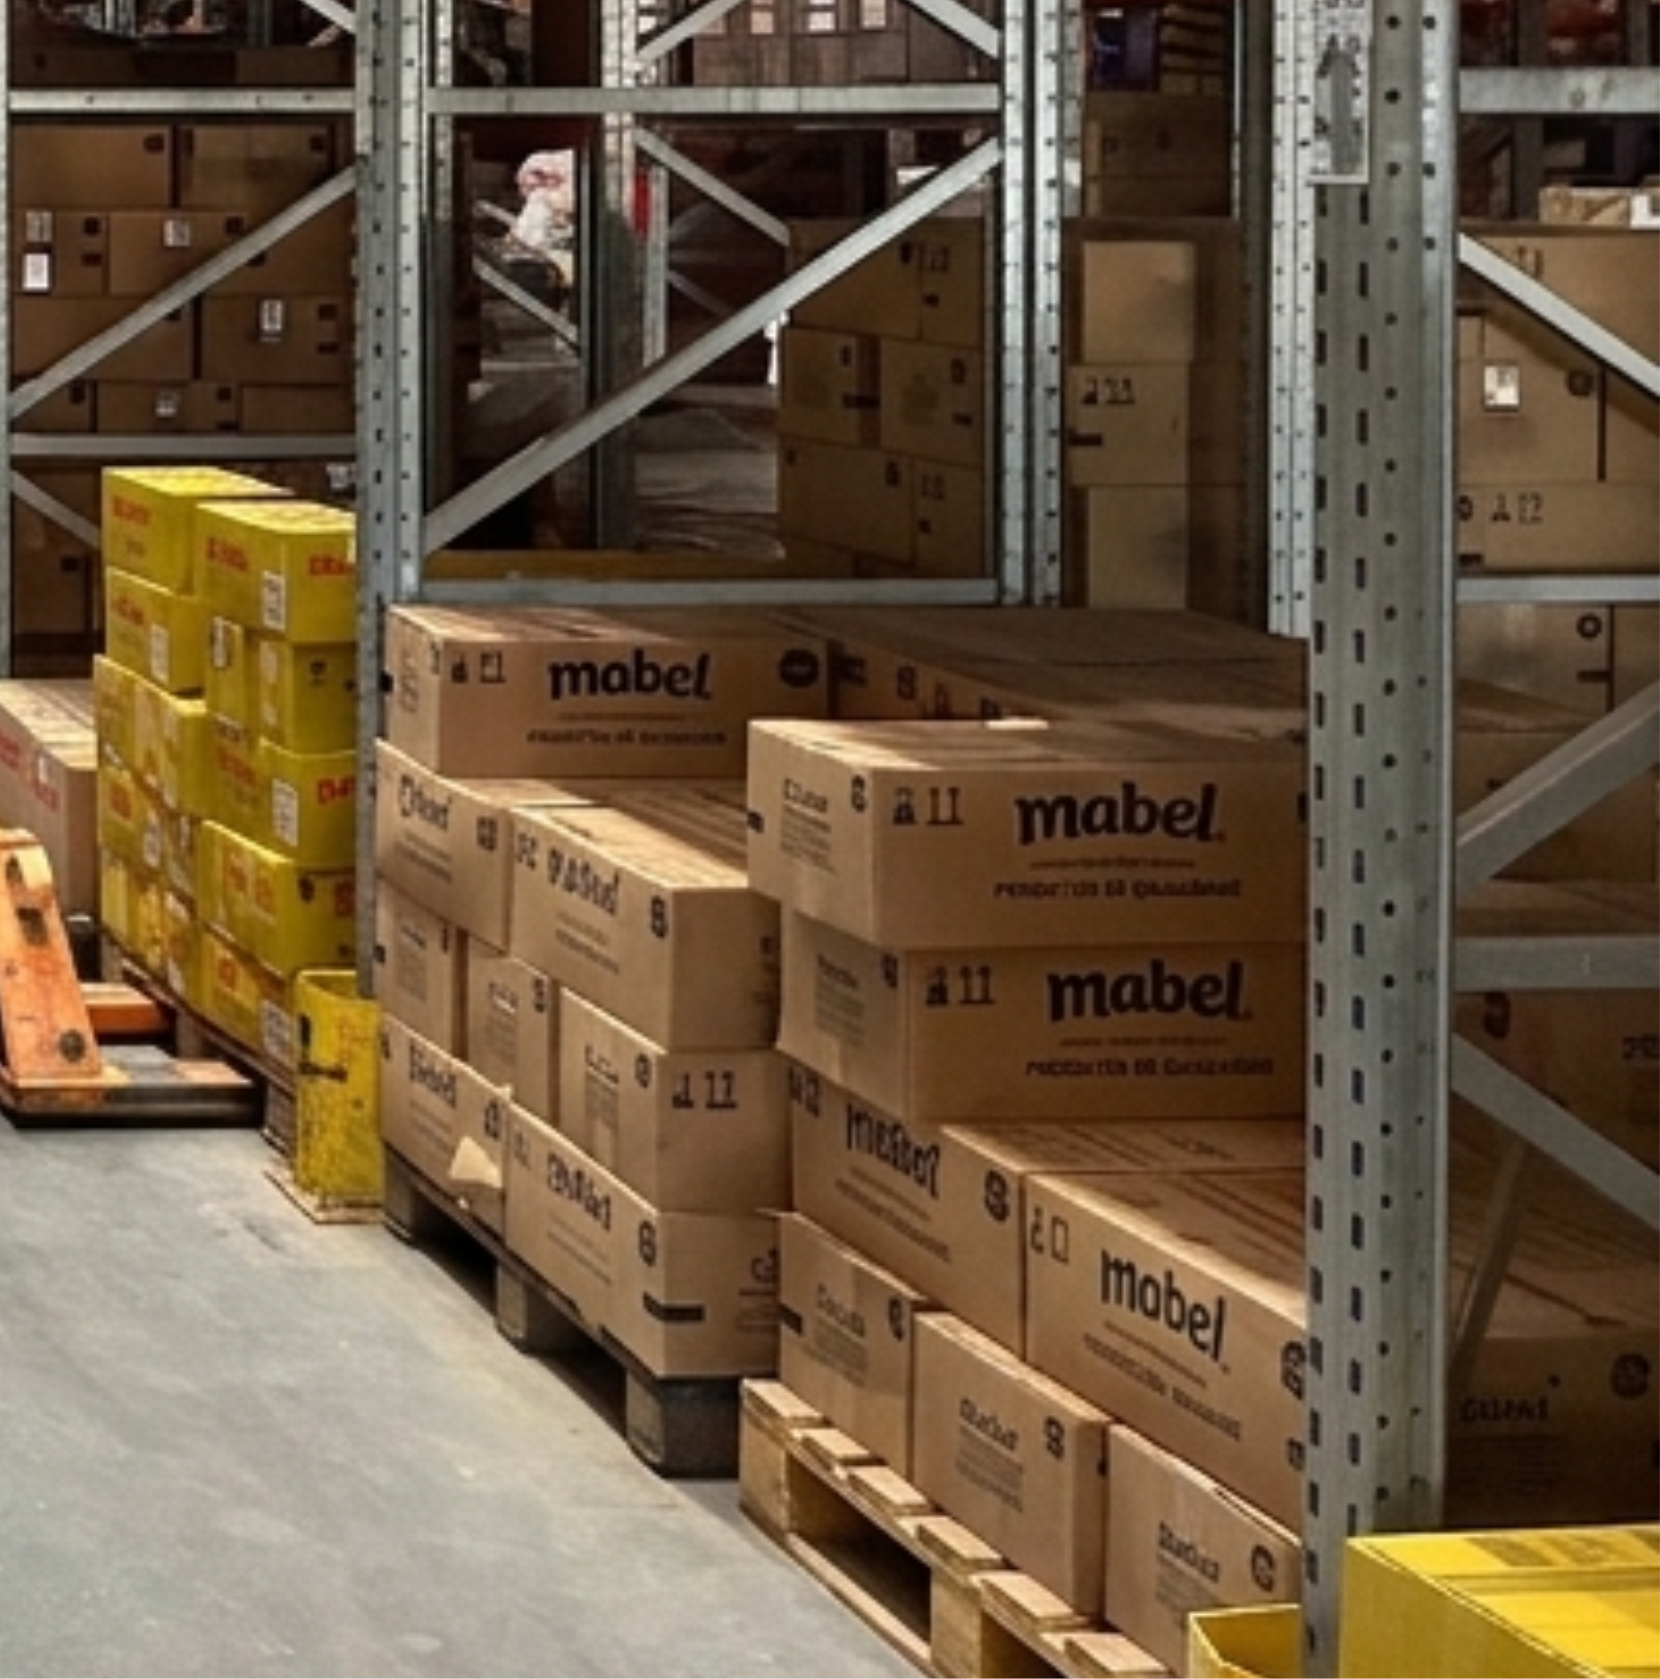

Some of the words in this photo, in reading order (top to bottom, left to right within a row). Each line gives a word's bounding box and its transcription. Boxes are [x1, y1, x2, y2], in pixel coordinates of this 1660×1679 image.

[547, 647, 713, 701] mabel
[1013, 779, 1219, 846] mabel
[1046, 957, 1245, 1023] mabel
[1101, 1249, 1226, 1363] mabel
